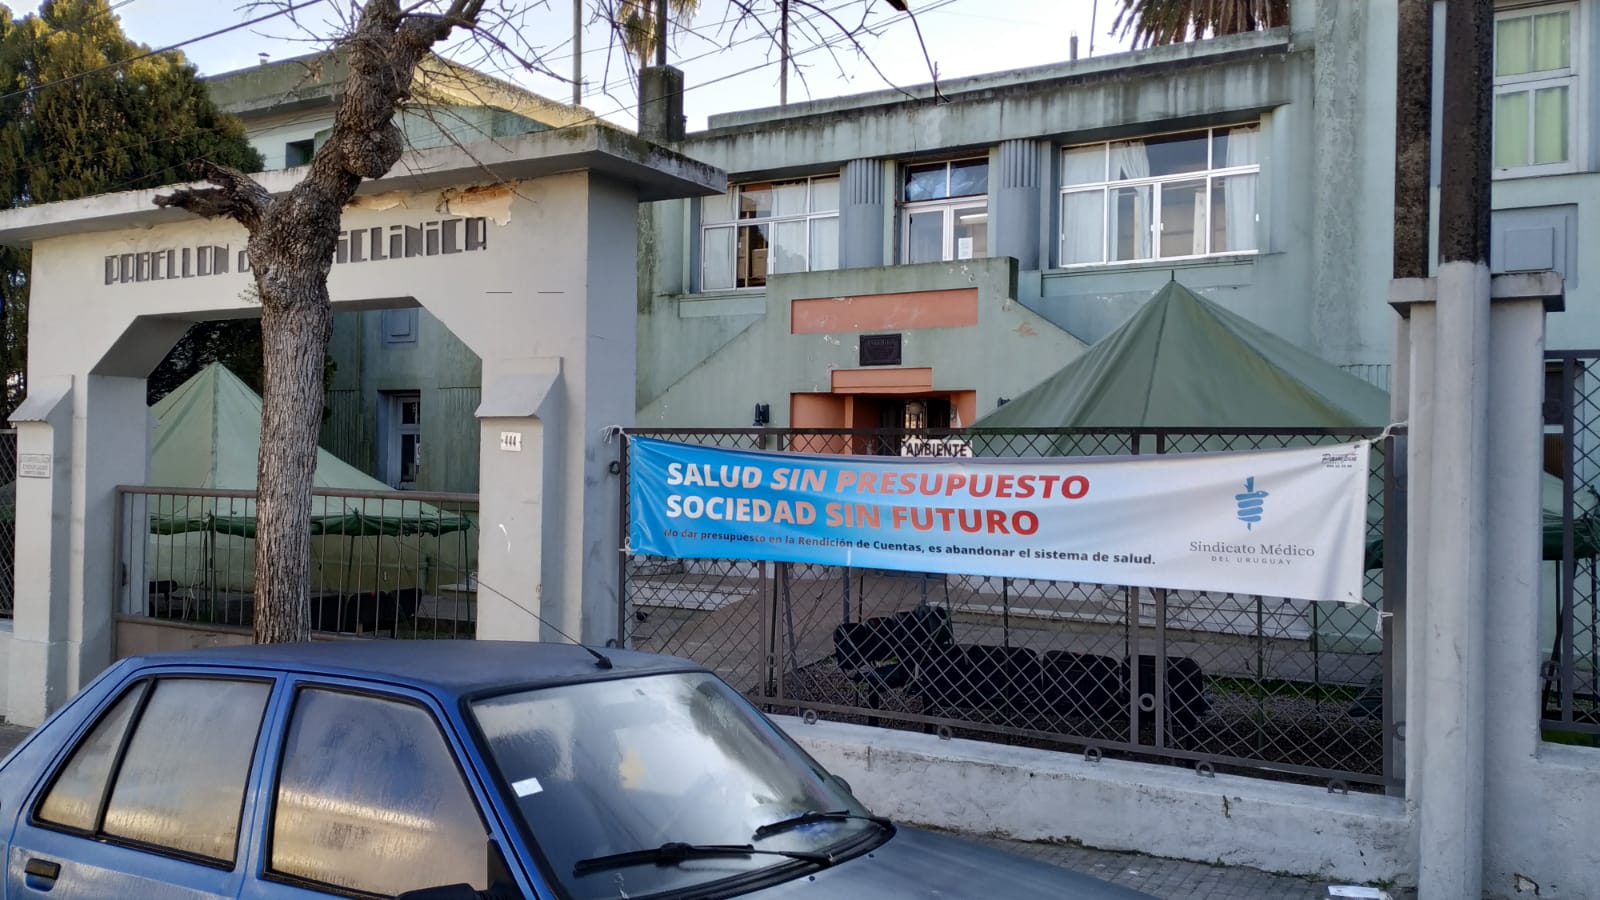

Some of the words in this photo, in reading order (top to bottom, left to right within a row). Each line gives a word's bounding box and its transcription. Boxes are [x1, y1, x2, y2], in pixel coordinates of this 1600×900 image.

[105, 243, 229, 285] PABELLON
[906, 442, 967, 457] AMBIENTE
[667, 462, 763, 489] SALUD
[770, 467, 828, 492] SIN
[835, 469, 1090, 500] PRESUPUESTO
[665, 494, 816, 525] SOCIEDAD
[825, 502, 880, 528] SIN
[892, 505, 1039, 536] FUTURO
[664, 529, 679, 538] No
[681, 529, 699, 539] dar
[701, 532, 766, 543] presupuesto
[785, 535, 795, 544] la
[798, 536, 853, 549] Rendición
[856, 540, 871, 550] de
[873, 541, 925, 554] Cuentas,
[928, 546, 942, 554] es
[945, 545, 1015, 558] abandonar
[1018, 548, 1031, 558] el
[1034, 549, 1089, 561] sistema
[1092, 552, 1110, 562] de
[1113, 553, 1156, 565] salud.
[1189, 541, 1256, 555] Sindicato
[1259, 544, 1315, 557] Médico
[1236, 557, 1292, 566] URUGUAY
